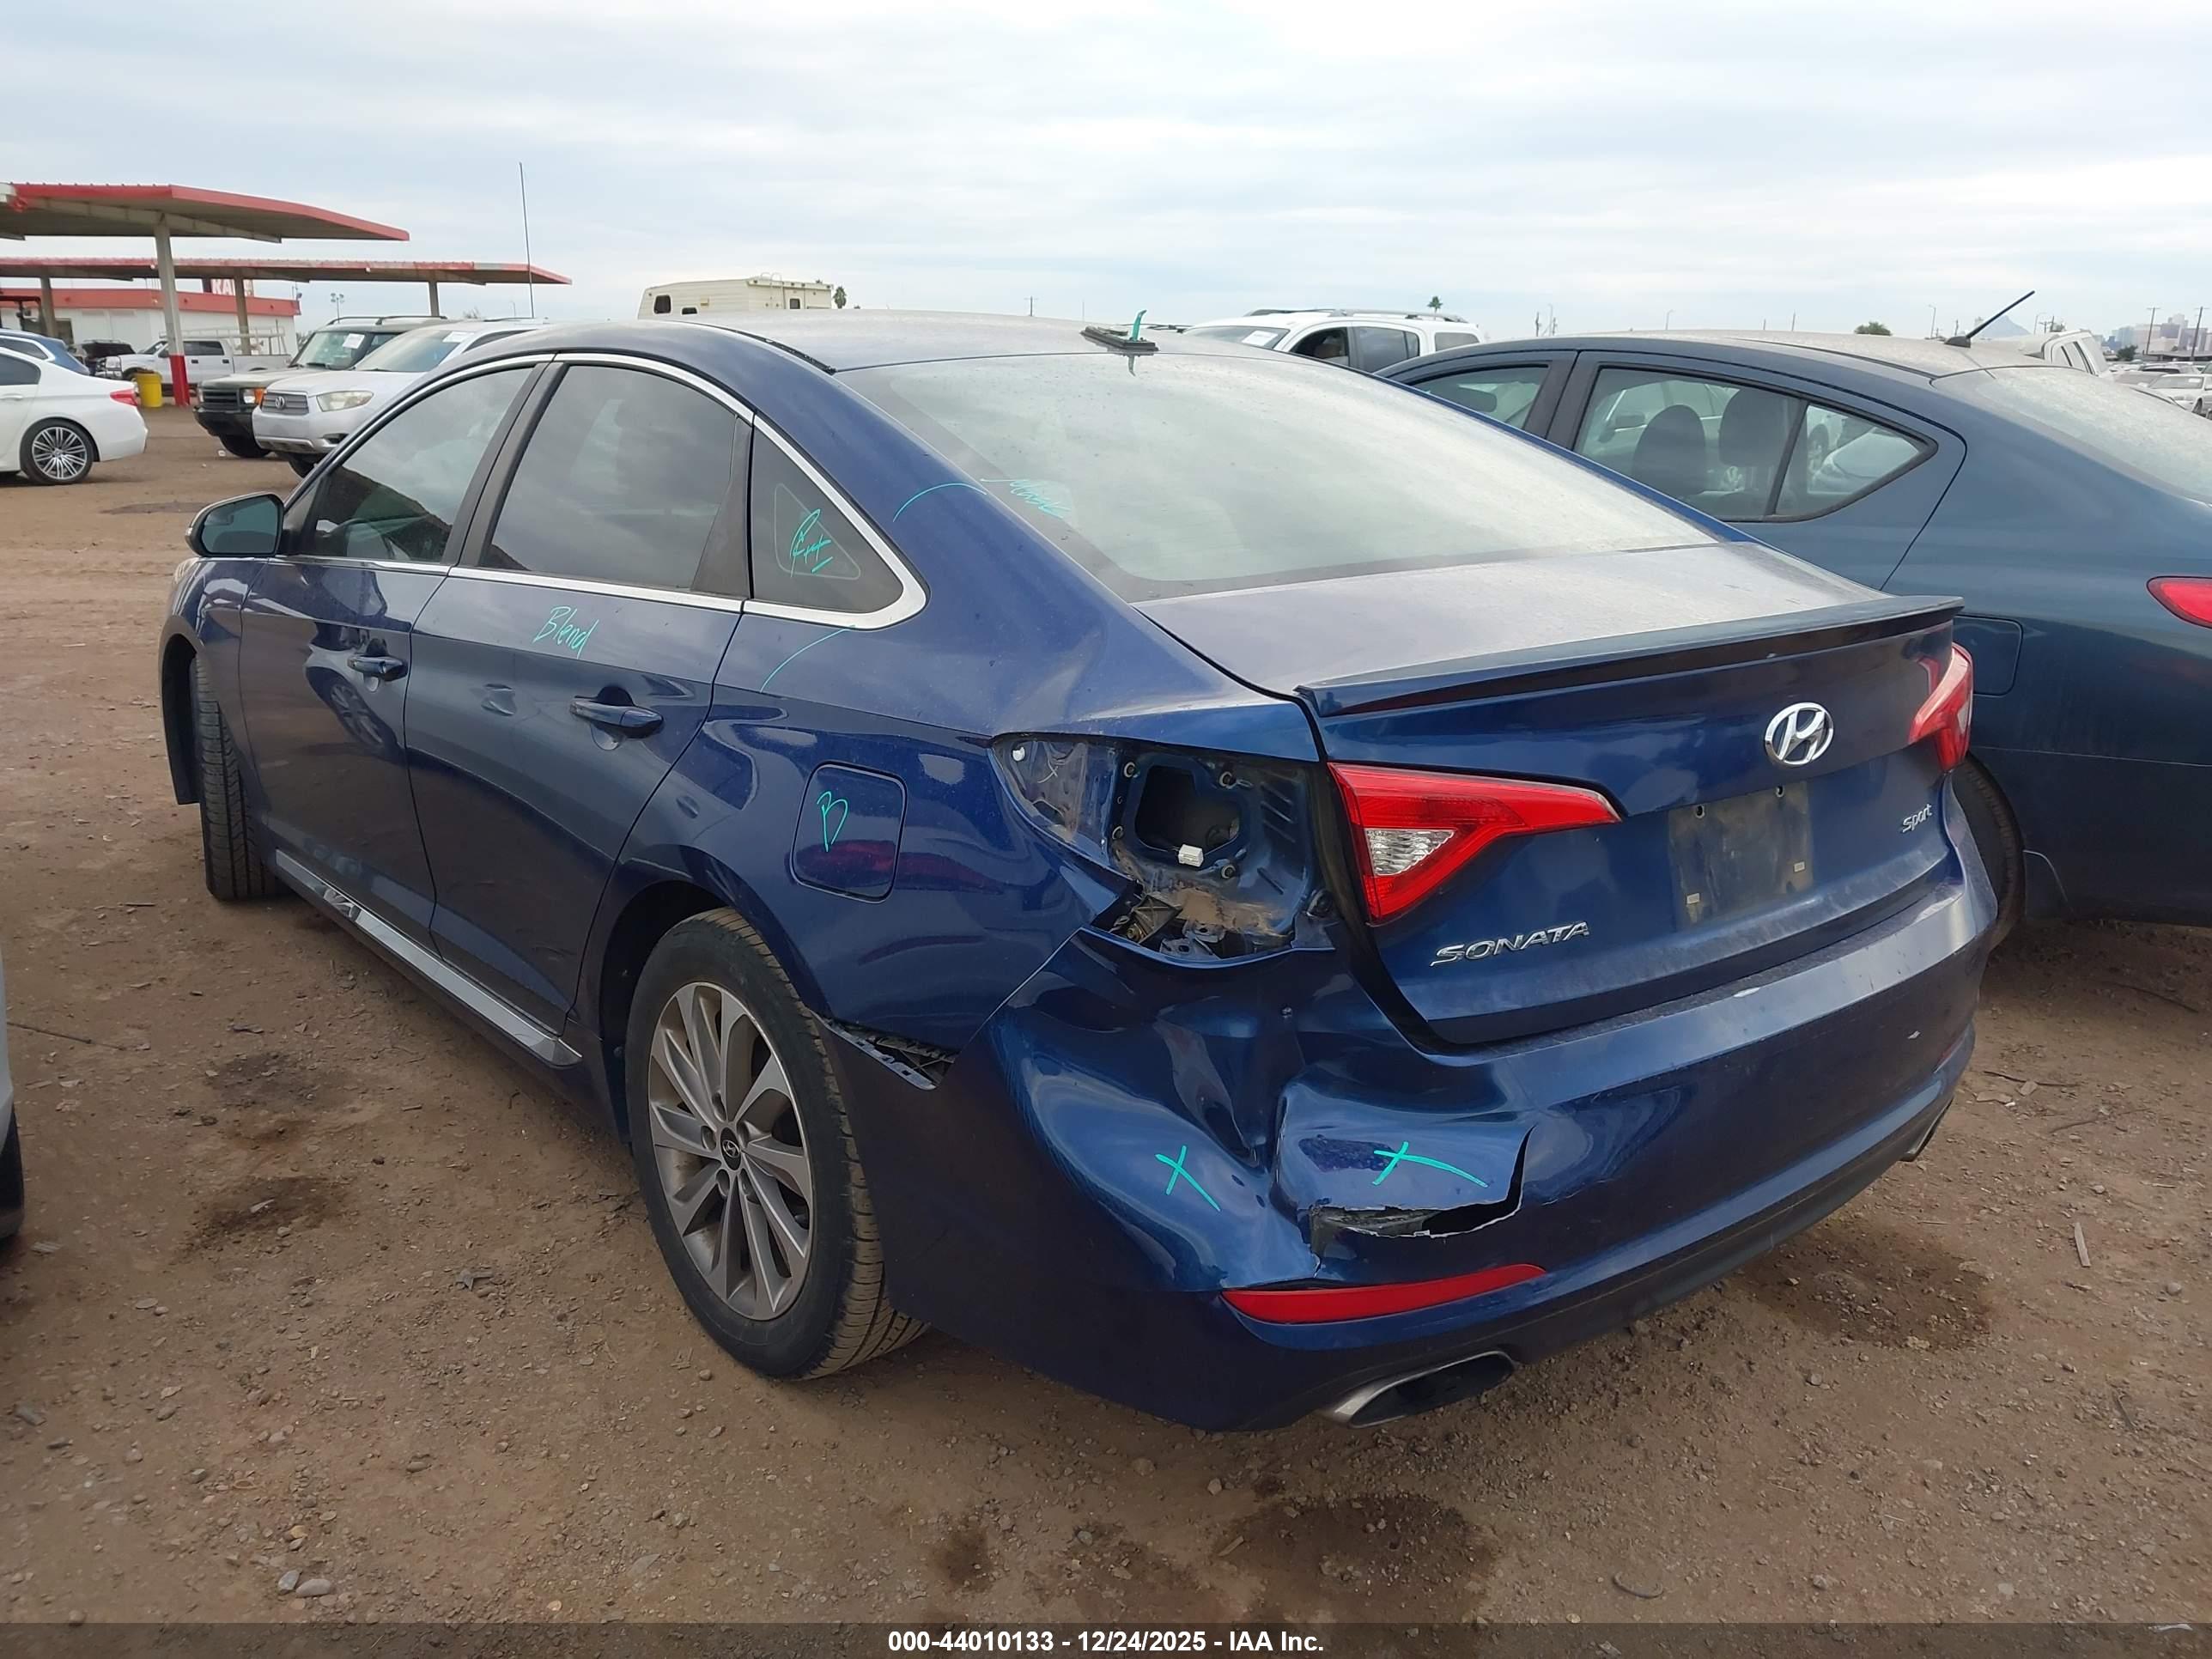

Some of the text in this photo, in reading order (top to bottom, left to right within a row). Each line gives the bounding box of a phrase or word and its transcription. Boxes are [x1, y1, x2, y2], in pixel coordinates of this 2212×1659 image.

[532, 605, 599, 659] Blend
[1902, 803, 1933, 833] Sport
[1429, 921, 1590, 967] SONATA
